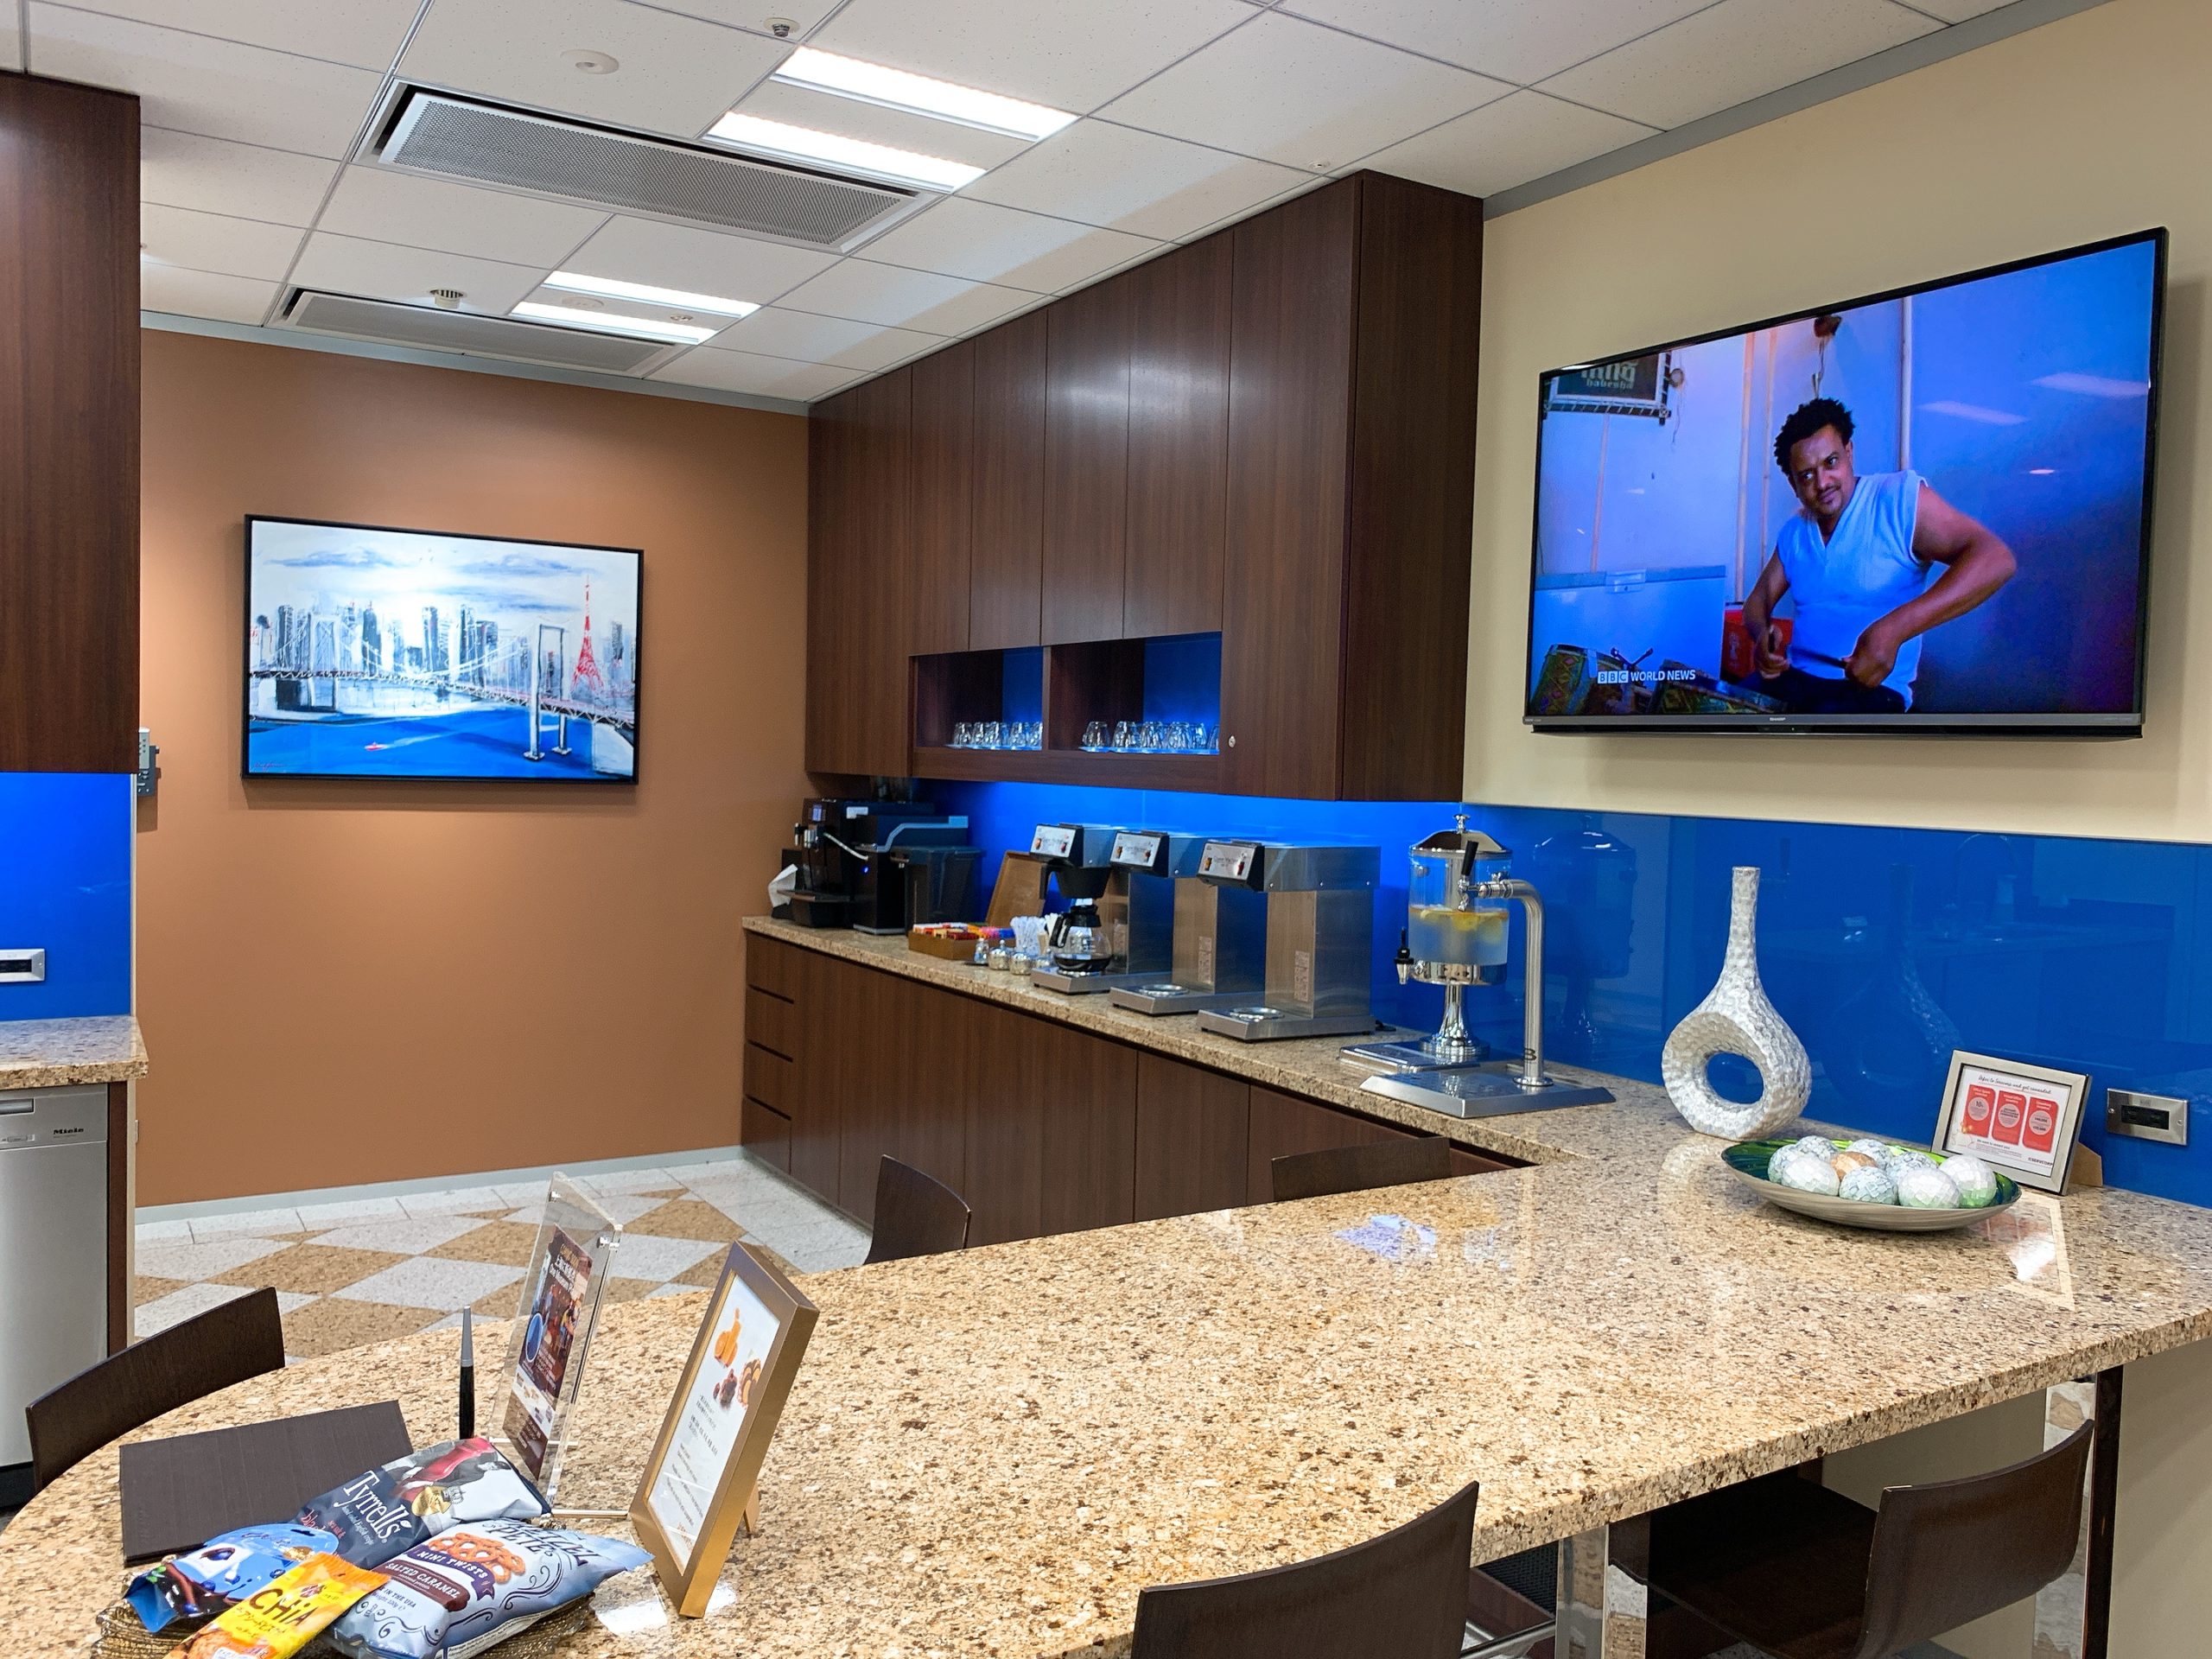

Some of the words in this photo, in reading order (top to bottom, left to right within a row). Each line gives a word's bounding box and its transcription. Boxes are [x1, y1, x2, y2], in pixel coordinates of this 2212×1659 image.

[1597, 670, 1629, 683] BBC
[1630, 671, 1665, 682] WORLD
[1666, 669, 1696, 681] NEWS
[416, 1551, 443, 1565] MINI
[445, 1557, 489, 1580] TWISTS
[385, 1562, 418, 1579] SALTED
[417, 1573, 462, 1599] CARAMEL
[391, 1592, 405, 1601] THE
[404, 1599, 416, 1608] USA
